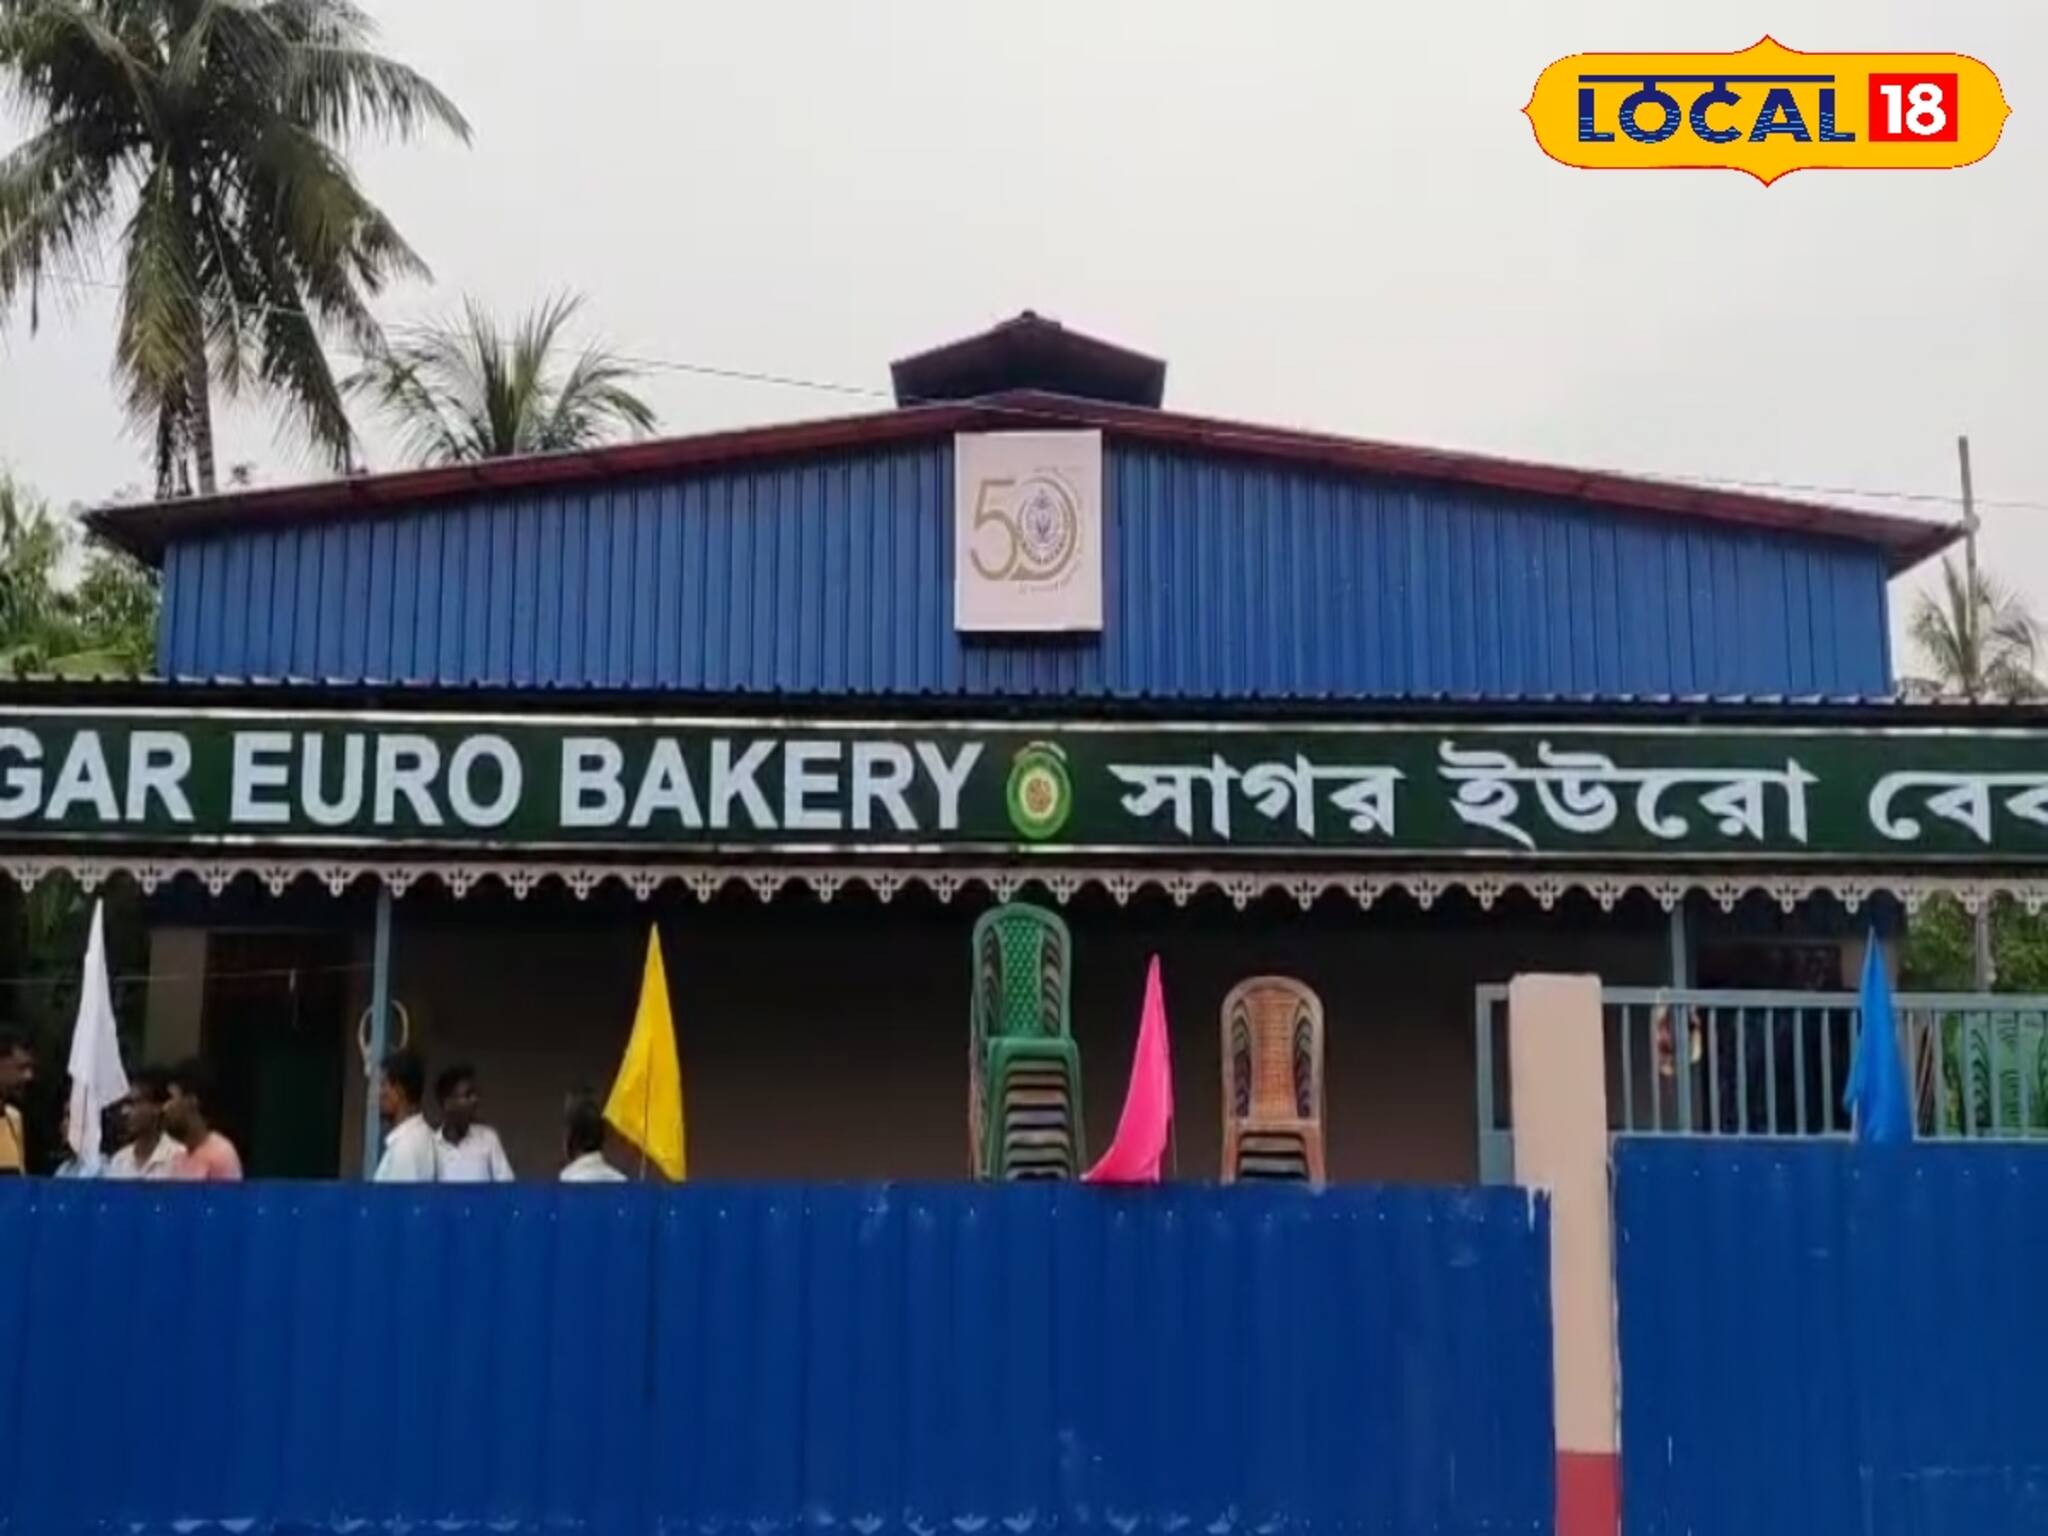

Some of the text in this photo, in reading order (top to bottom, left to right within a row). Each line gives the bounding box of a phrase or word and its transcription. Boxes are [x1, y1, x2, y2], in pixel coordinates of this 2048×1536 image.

[970, 476, 1077, 581] 50
[231, 732, 523, 826] EURO
[560, 737, 984, 830] BAKERY
[1107, 753, 1407, 839] সাগর
[1438, 740, 1820, 851] ইউরো
